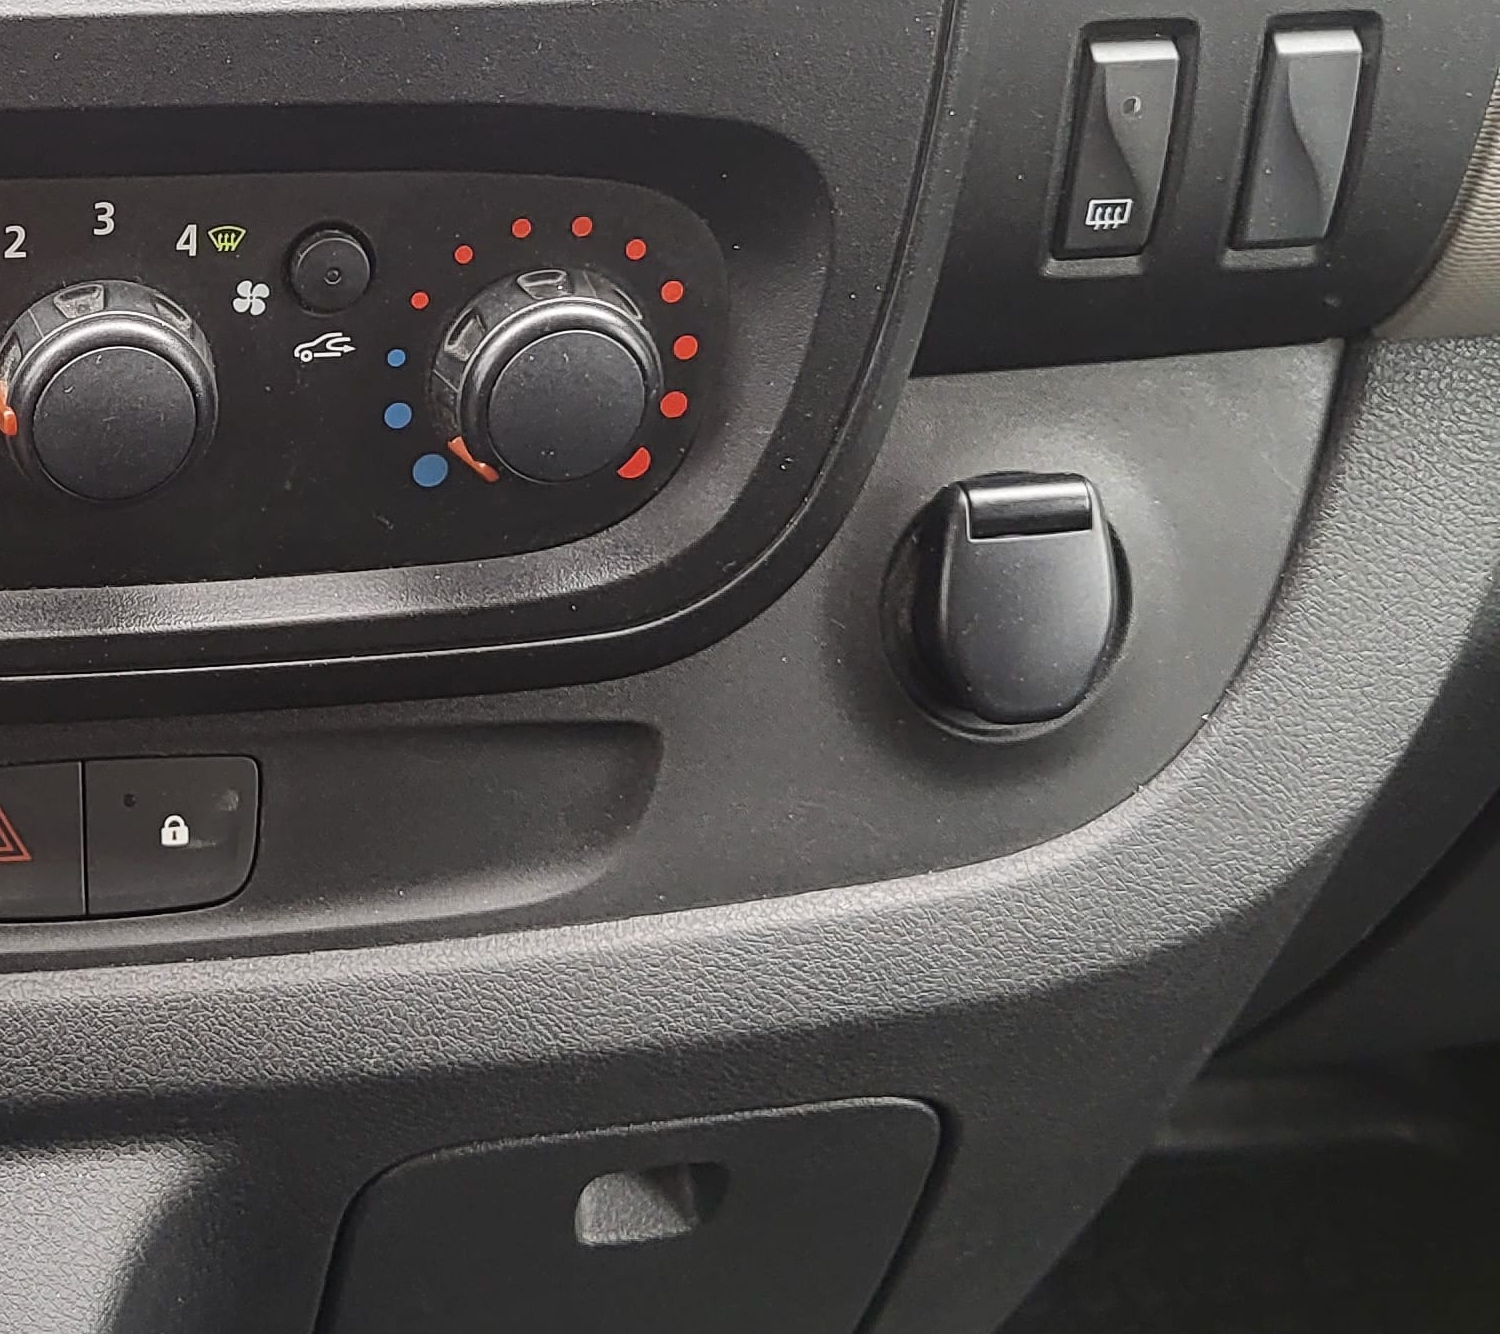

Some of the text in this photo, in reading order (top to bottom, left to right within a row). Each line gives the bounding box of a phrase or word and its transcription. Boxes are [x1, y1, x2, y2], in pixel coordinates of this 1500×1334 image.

[92, 202, 116, 237] 3
[3, 225, 27, 259] 2
[175, 224, 200, 257] 4
